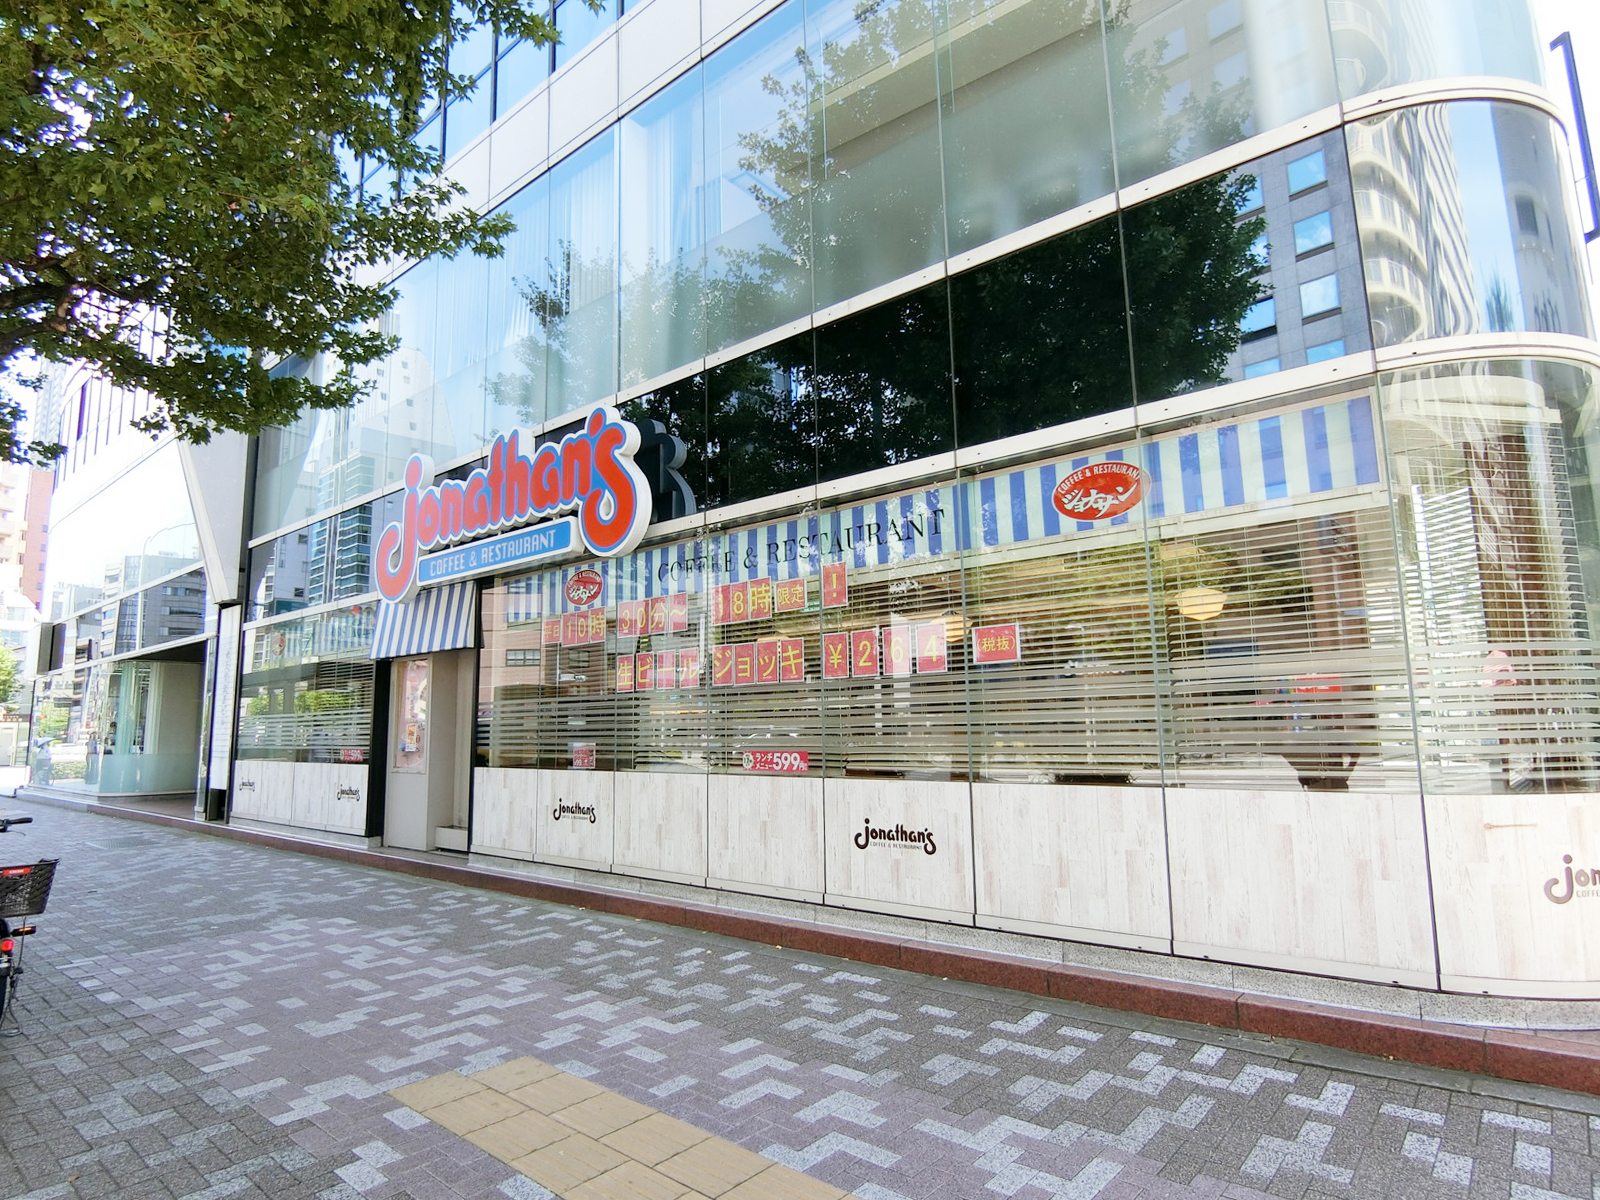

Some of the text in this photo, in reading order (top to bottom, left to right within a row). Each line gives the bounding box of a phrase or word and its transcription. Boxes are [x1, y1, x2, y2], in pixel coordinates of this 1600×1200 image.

[1057, 471, 1084, 494] COFFEE
[1085, 469, 1092, 477] &
[429, 529, 556, 577] COFFEE & RESTAURANT
[743, 546, 758, 569] &
[766, 508, 945, 566] RESTAURANT
[755, 752, 773, 762] ランチ
[553, 798, 596, 824] jonathan's
[854, 817, 937, 855] jonathan's
